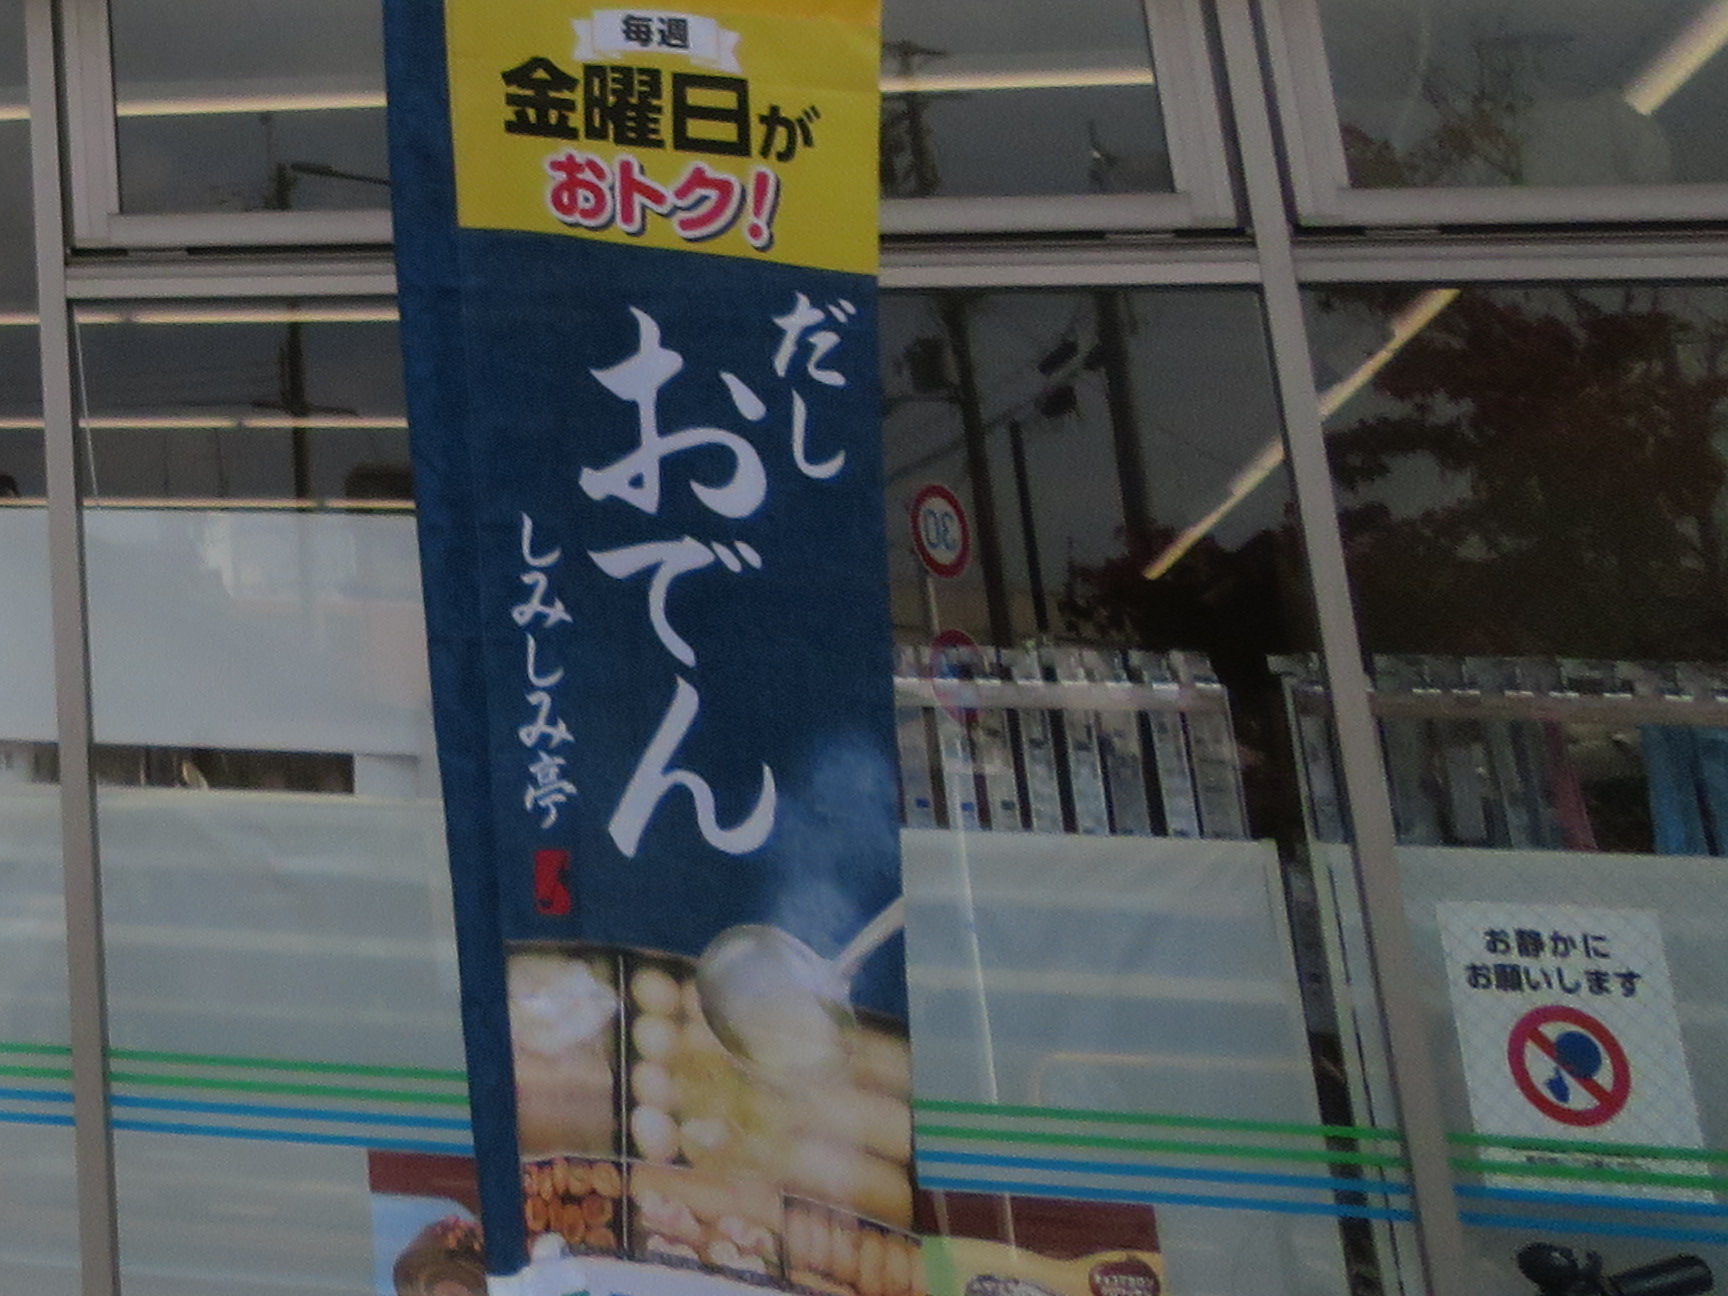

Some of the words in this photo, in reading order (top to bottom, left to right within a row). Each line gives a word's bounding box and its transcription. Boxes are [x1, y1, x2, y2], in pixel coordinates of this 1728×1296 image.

[620, 14, 690, 49] 毎週
[501, 57, 822, 164] 金曜日が
[545, 152, 780, 251] おトク!
[772, 290, 858, 480] だし
[578, 304, 776, 860] おでん
[510, 511, 578, 828] しみしみ亭
[1465, 963, 1641, 997] お願いします
[1484, 928, 1611, 959] お静かに
